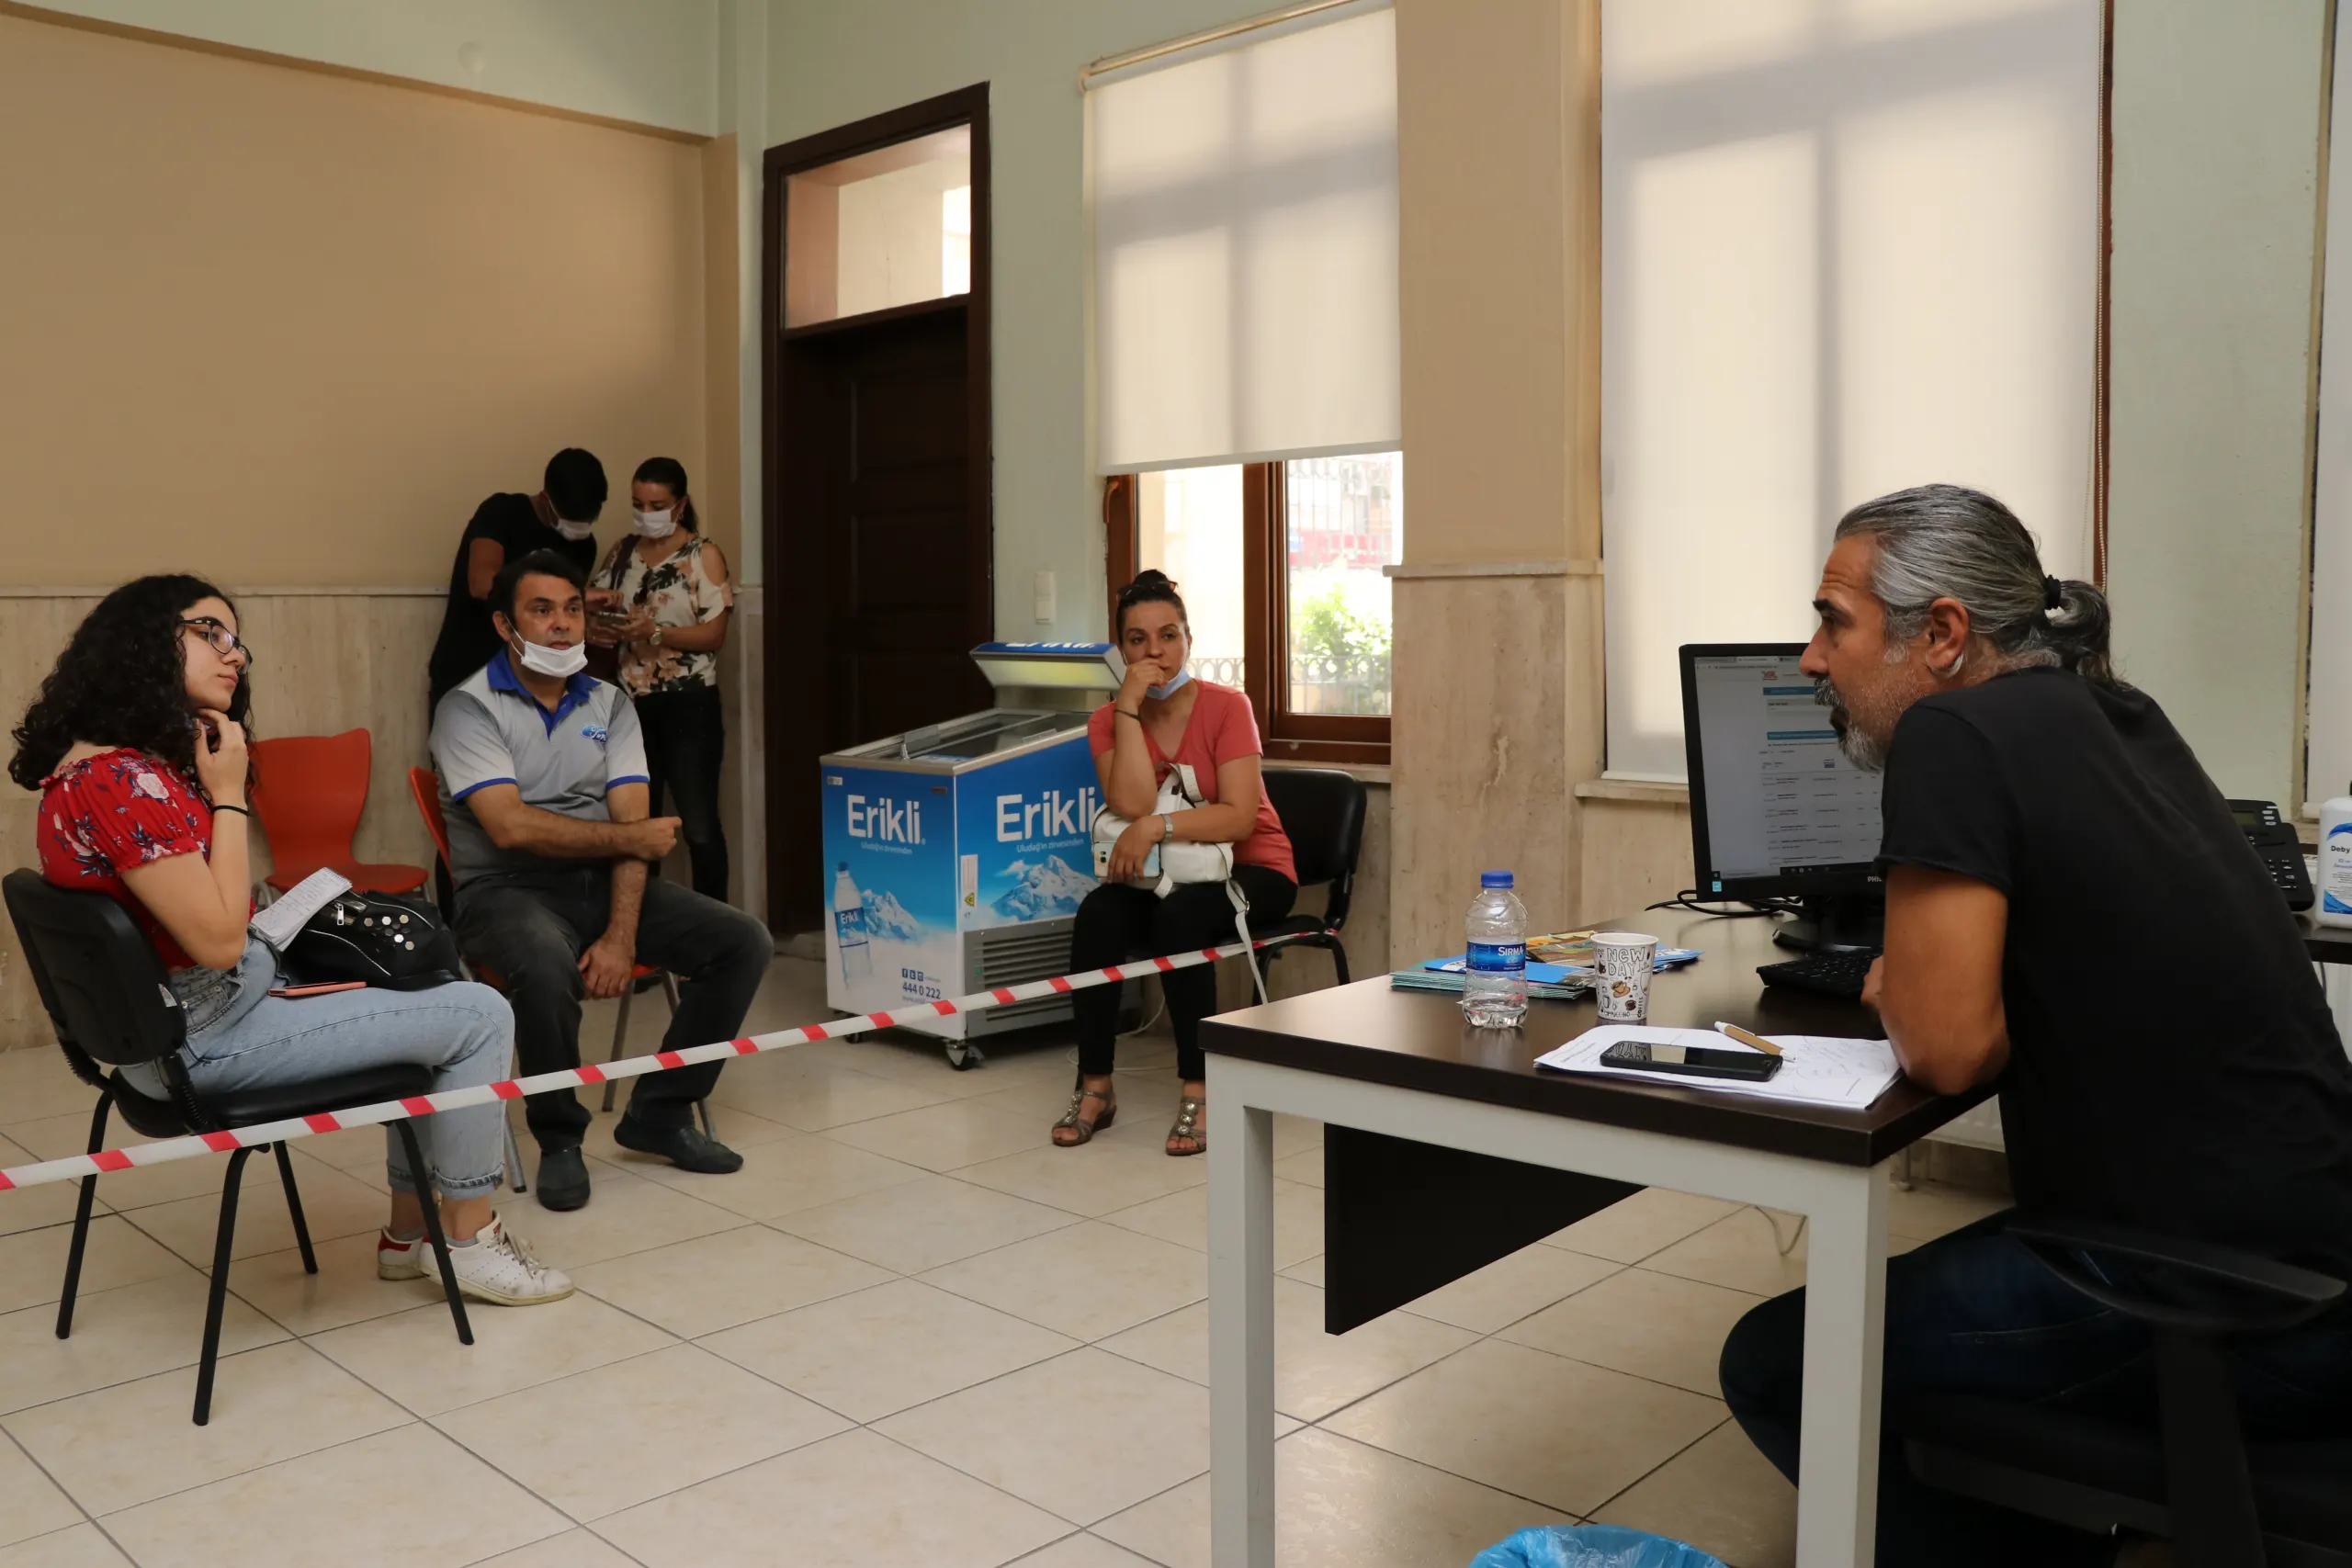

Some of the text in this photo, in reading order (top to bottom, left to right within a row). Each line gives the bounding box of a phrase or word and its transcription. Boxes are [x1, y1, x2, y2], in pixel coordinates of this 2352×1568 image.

[848, 795, 921, 844] Erikli
[997, 787, 1095, 842] Erikli
[2331, 845, 2350, 854] Deby
[1608, 963, 1636, 976] DAY
[903, 982, 917, 994] 444
[919, 985, 924, 996] 0
[926, 987, 941, 999] 222
